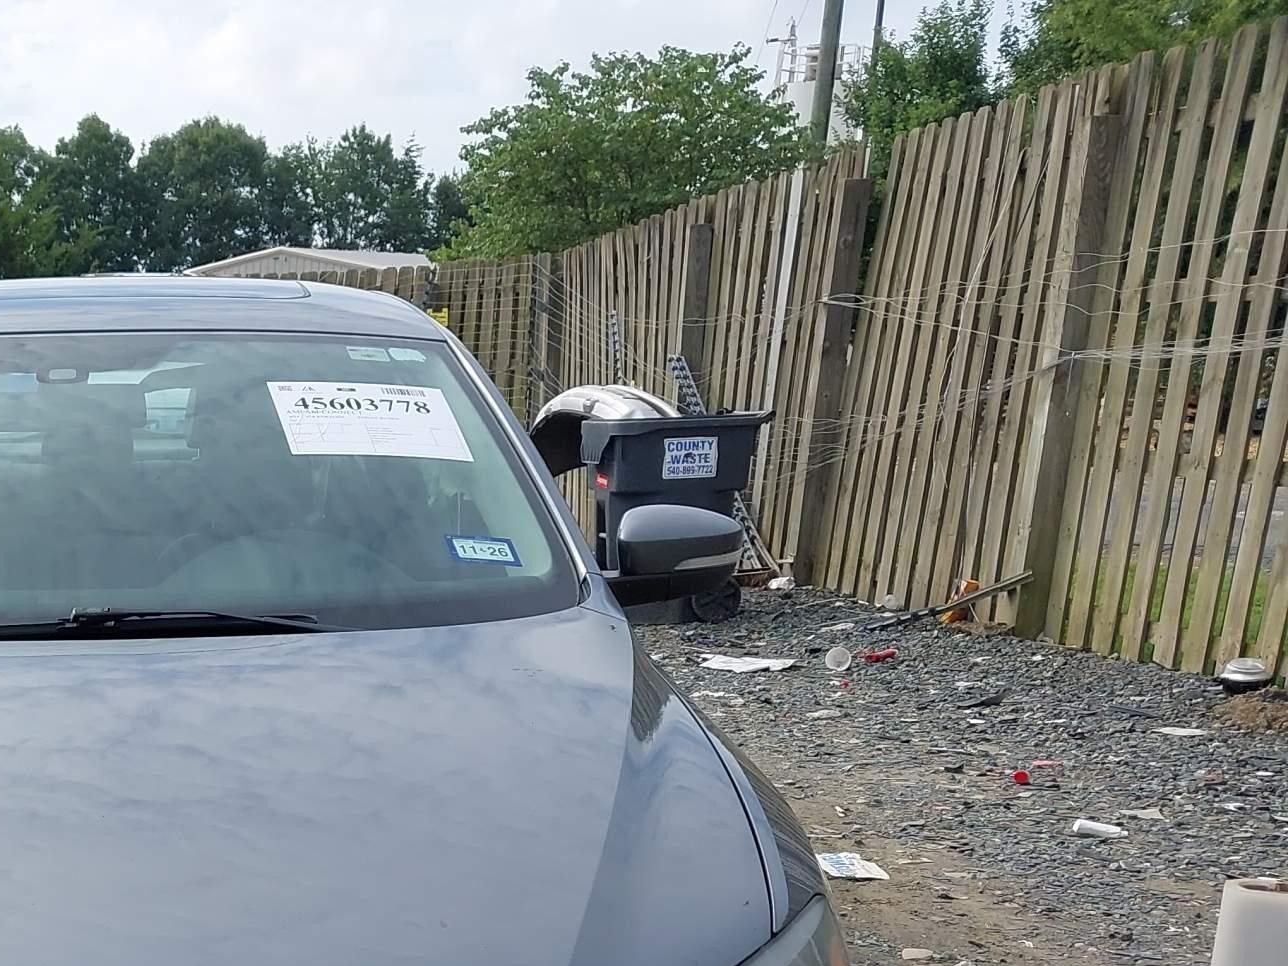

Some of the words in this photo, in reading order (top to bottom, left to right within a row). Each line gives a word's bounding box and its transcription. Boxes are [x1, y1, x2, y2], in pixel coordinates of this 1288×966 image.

[294, 396, 431, 415] 45603778
[668, 440, 714, 452] COUNTY
[670, 453, 710, 465] WASTE
